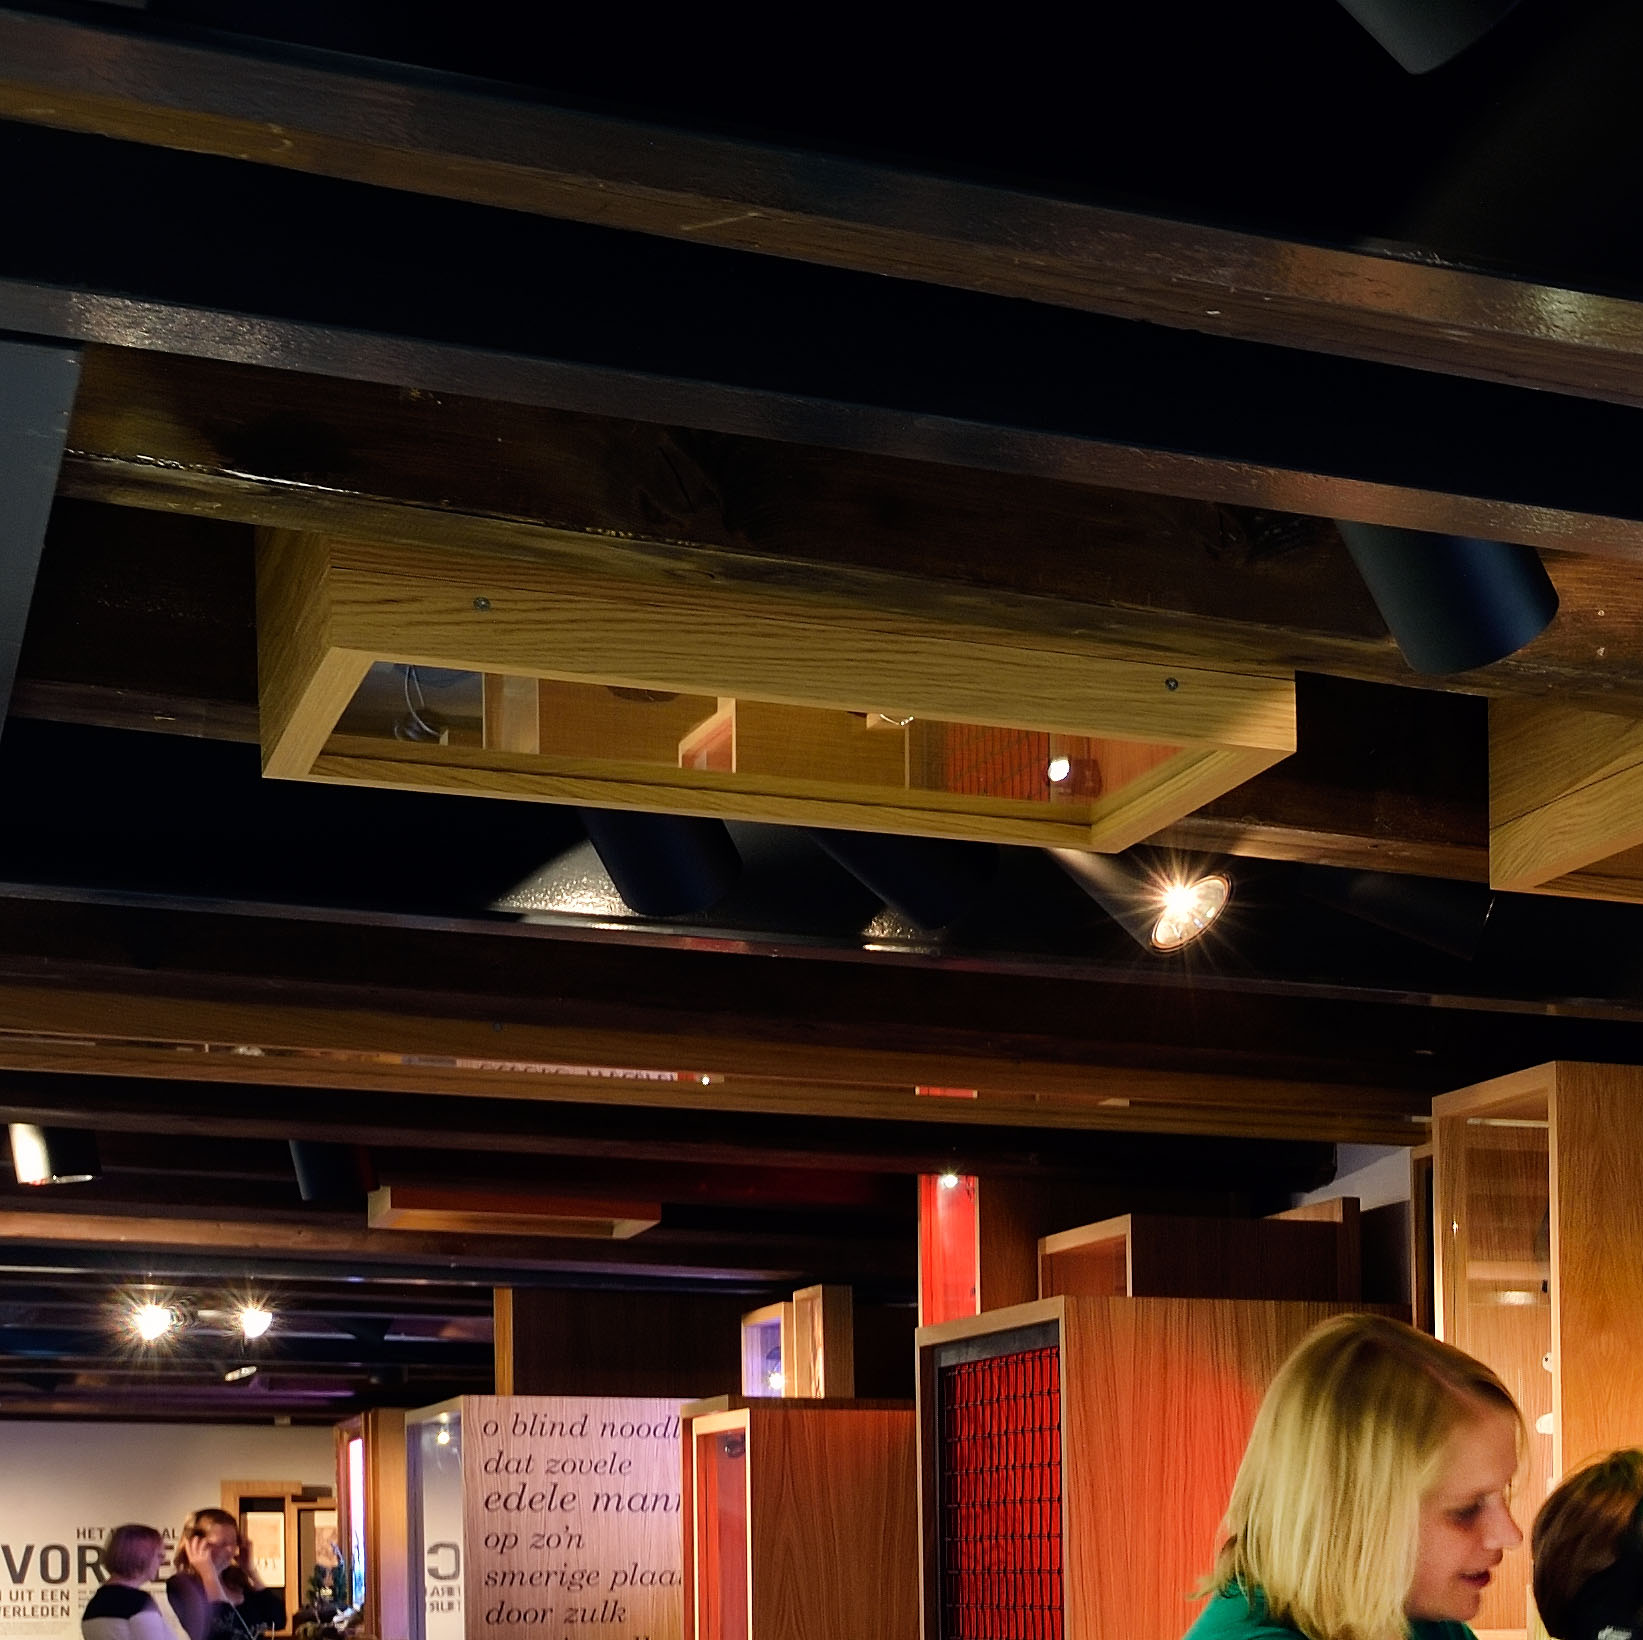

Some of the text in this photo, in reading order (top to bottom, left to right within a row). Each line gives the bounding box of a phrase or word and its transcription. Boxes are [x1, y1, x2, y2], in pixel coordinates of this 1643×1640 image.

[483, 1413, 680, 1439] o blind noodl
[484, 1450, 632, 1476] dat zovele
[484, 1483, 577, 1513] edele
[76, 1527, 105, 1540] HET
[484, 1531, 518, 1554] op
[484, 1562, 600, 1592] smerige
[9, 1589, 33, 1602] UIT
[41, 1589, 70, 1602] EEN
[485, 1601, 553, 1625] door
[563, 1600, 626, 1624] zulk
